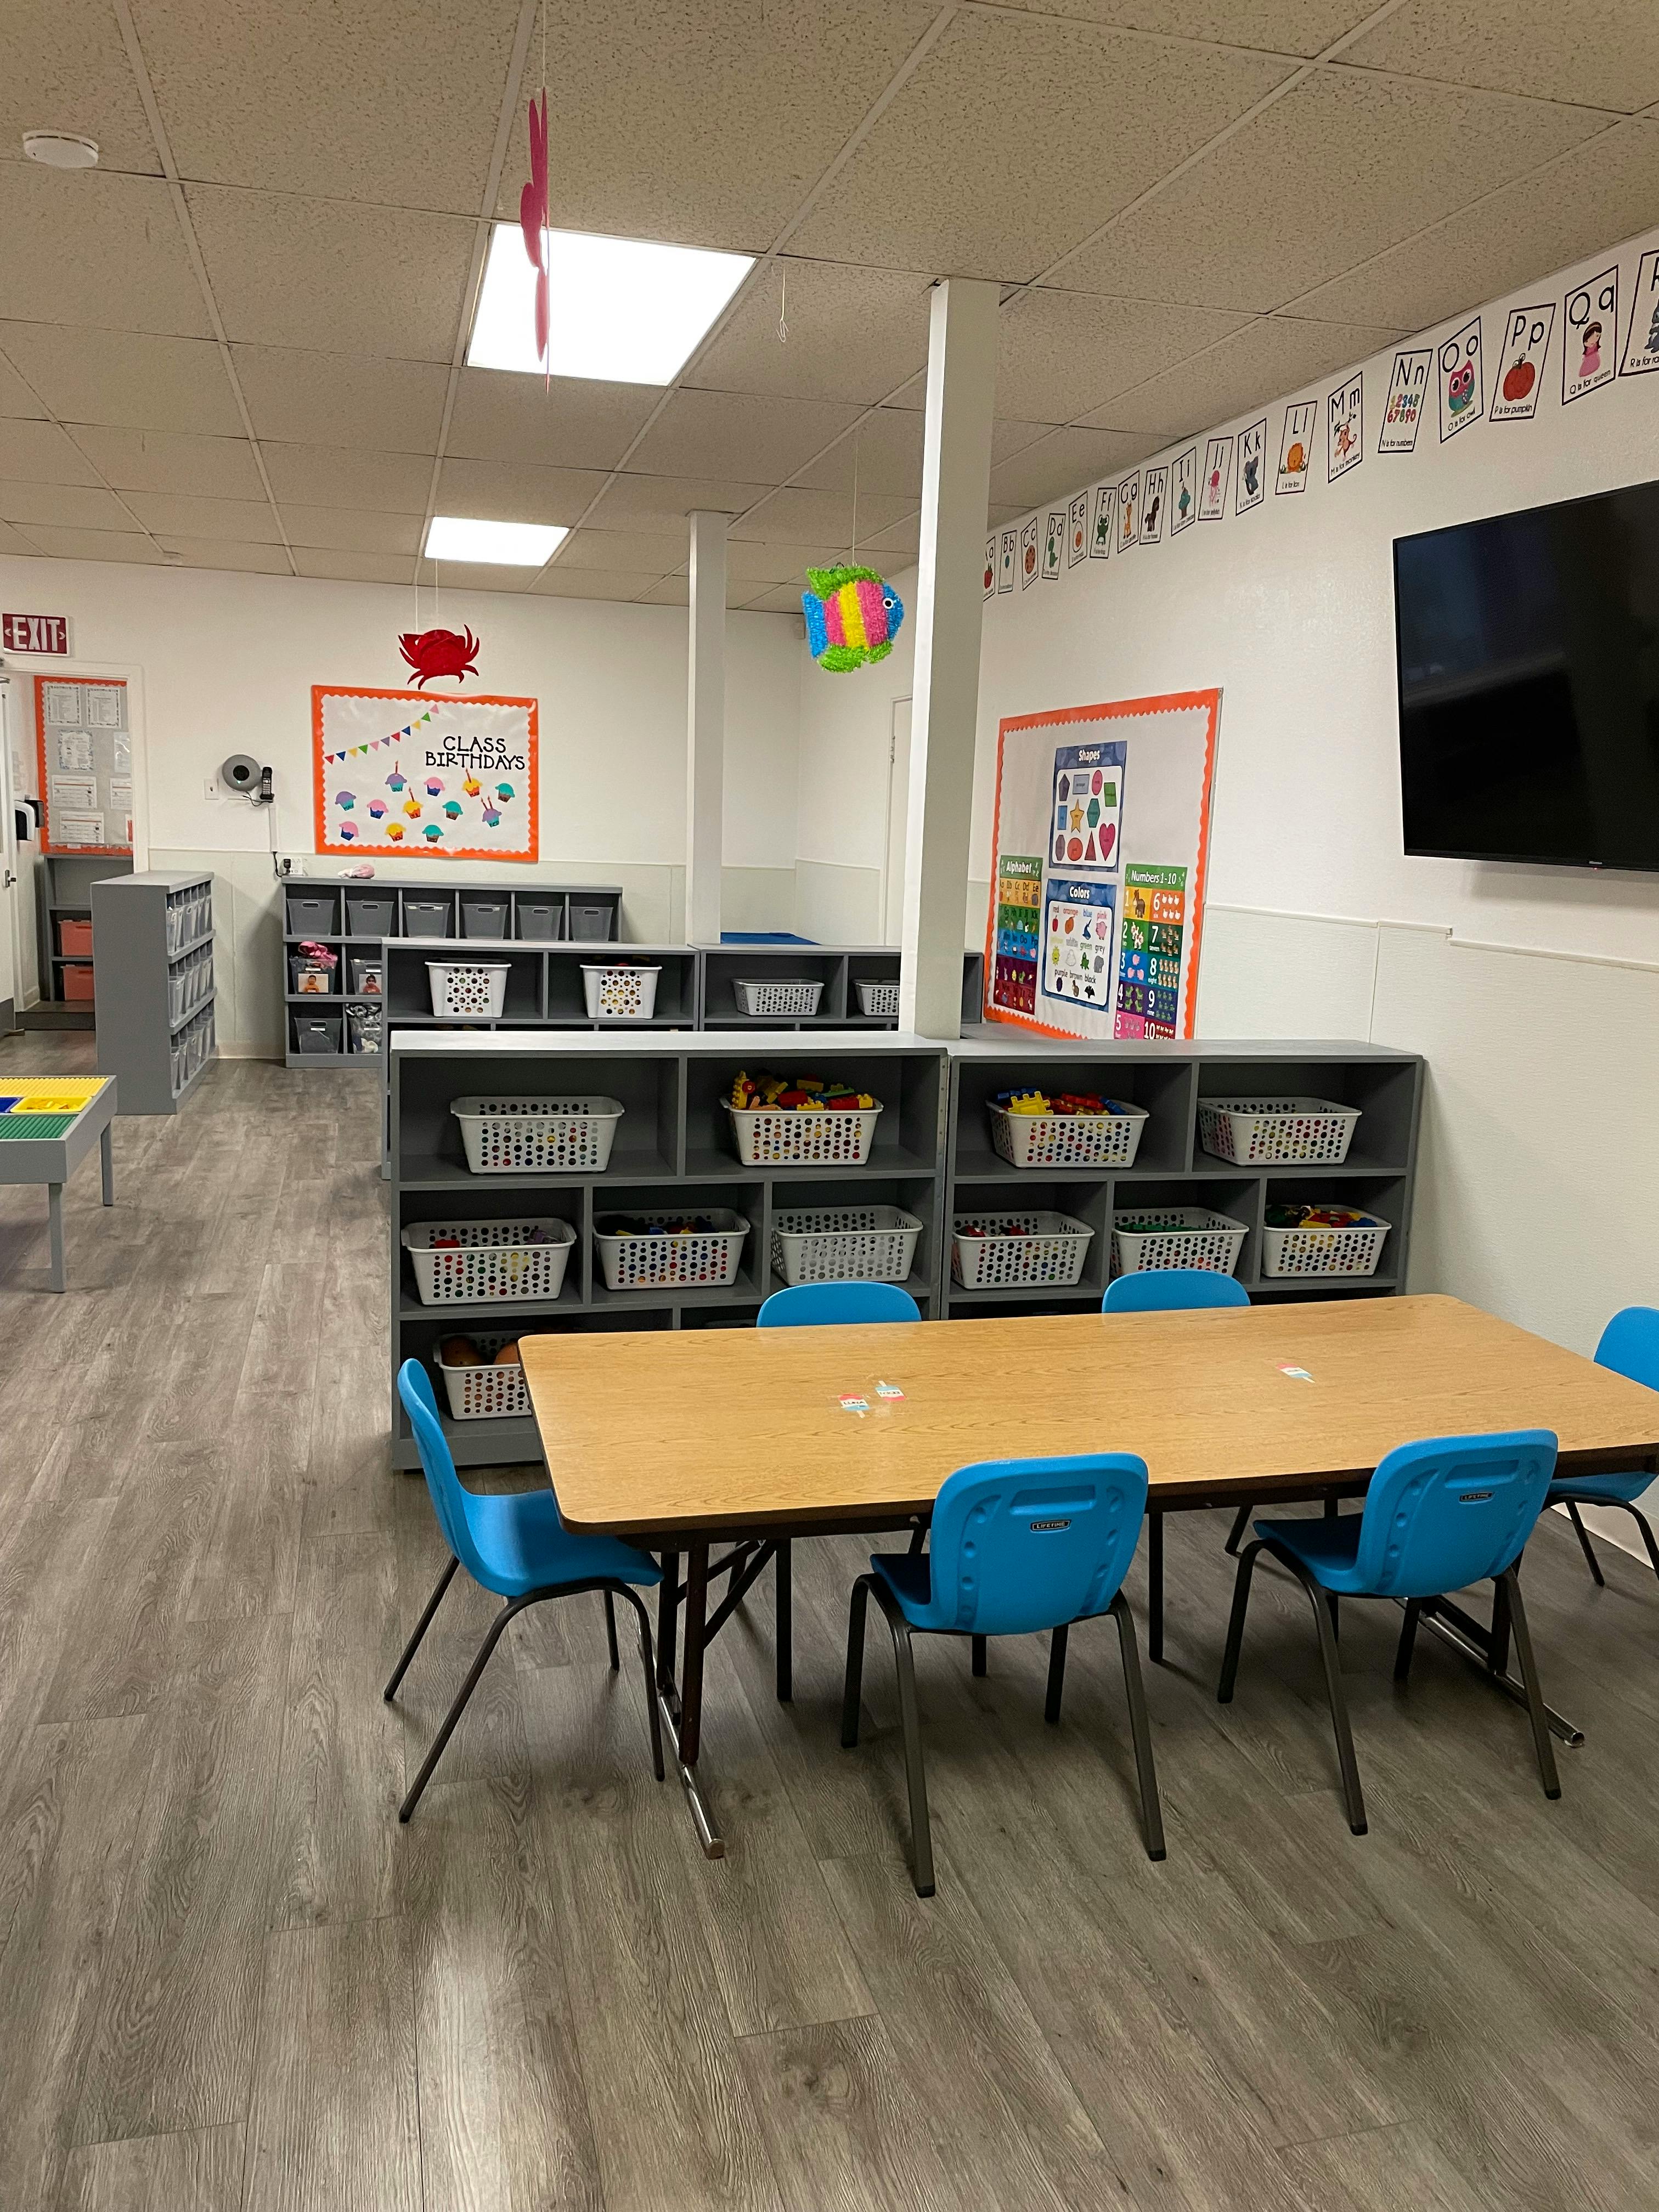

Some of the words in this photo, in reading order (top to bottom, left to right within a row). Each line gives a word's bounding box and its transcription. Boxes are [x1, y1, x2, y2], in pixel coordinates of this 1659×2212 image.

[1569, 285, 1615, 329] Qq
[1511, 315, 1544, 351] Pp
[1442, 335, 1479, 373] Oo
[1630, 358, 1636, 368] R
[1637, 357, 1640, 366] is
[1642, 356, 1651, 366] for
[1396, 357, 1424, 387] Nn
[1570, 385, 1576, 394] Q
[1583, 378, 1592, 388] for
[1594, 370, 1611, 382] queen
[1331, 388, 1360, 422] Mm
[1494, 405, 1498, 415] P
[1511, 404, 1532, 415] pumpkin
[1448, 422, 1453, 431] O
[1244, 431, 1261, 458] Kk
[1179, 459, 1190, 482] Ii
[1149, 472, 1163, 494] Hh
[1120, 483, 1137, 504] Gg
[1072, 504, 1085, 523] Ee
[1049, 517, 1064, 536] Dd
[1003, 535, 1014, 553] Bb
[1023, 528, 1036, 548] Cc
[13, 617, 60, 651] EXIT
[443, 736, 506, 753] CLASS
[425, 752, 525, 770] BIRTHDAYS
[1079, 749, 1100, 763] Shapes
[1006, 861, 1032, 874] Alphabet
[1131, 870, 1159, 883] Numbers
[1069, 886, 1090, 899] Colors
[1125, 890, 1129, 906] 1
[1153, 893, 1160, 911] 6
[1083, 908, 1092, 918] blue
[1122, 921, 1128, 938] 2
[1152, 926, 1159, 943] 7
[1094, 945, 1105, 955] grey
[1120, 952, 1125, 969] 3
[1150, 957, 1157, 975] 8
[1054, 969, 1068, 977] purple
[1069, 970, 1082, 980] brown
[1084, 974, 1096, 984] black
[1118, 984, 1123, 1001] 4
[1148, 990, 1155, 1008] 9
[1115, 1014, 1121, 1031] 5
[1144, 1021, 1155, 1040] 10
